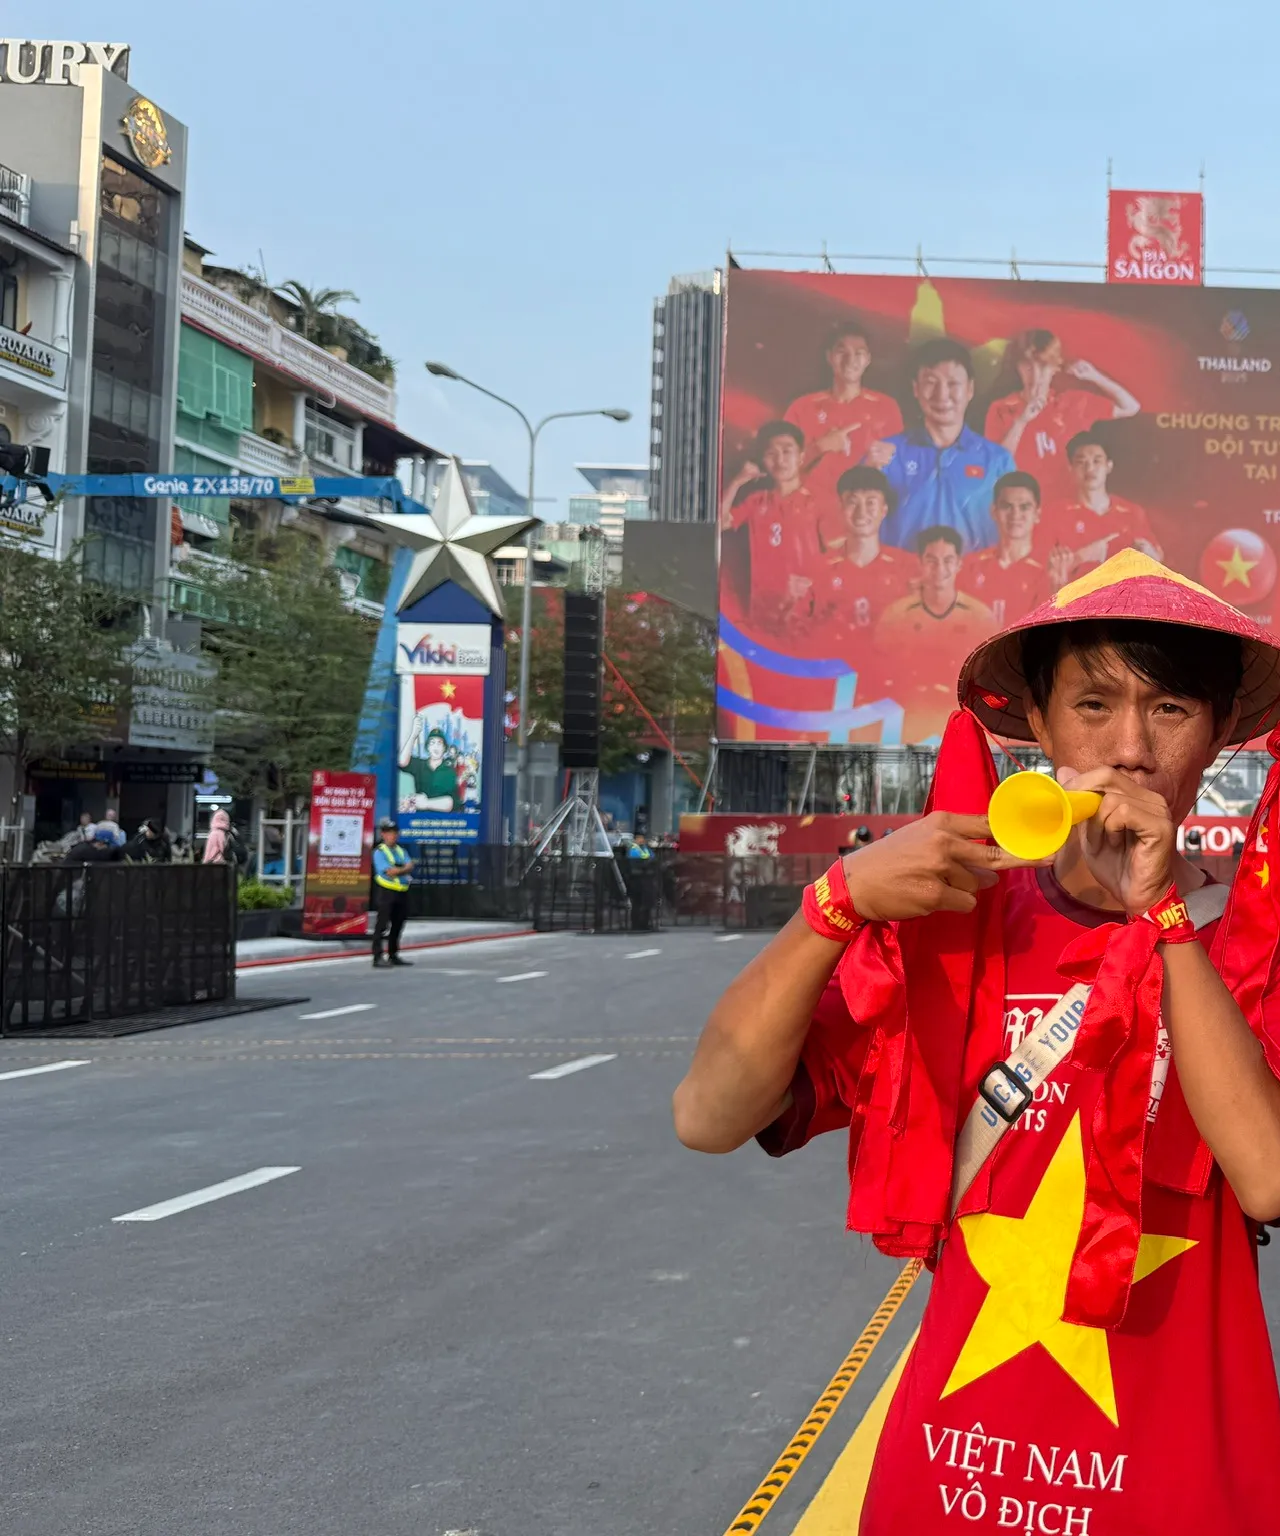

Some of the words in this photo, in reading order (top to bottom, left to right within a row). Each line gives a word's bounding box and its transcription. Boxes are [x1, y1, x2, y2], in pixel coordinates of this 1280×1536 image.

[0, 38, 128, 86] URY
[1141, 248, 1167, 262] BIA
[1114, 257, 1195, 280] SAIGON
[1197, 356, 1272, 373] THAILAND
[1156, 413, 1250, 431] CHƯƠNG
[1205, 435, 1244, 460] ĐỘI
[144, 477, 189, 494] Genie
[1244, 464, 1277, 484] TẠI
[399, 633, 458, 664] Vikki
[1156, 902, 1188, 929] VIỆT
[922, 1422, 1015, 1481] VIỆT
[1023, 1443, 1128, 1493] NAM
[938, 1481, 986, 1520] VÔ
[998, 1496, 1092, 1536] ĐỊCH
